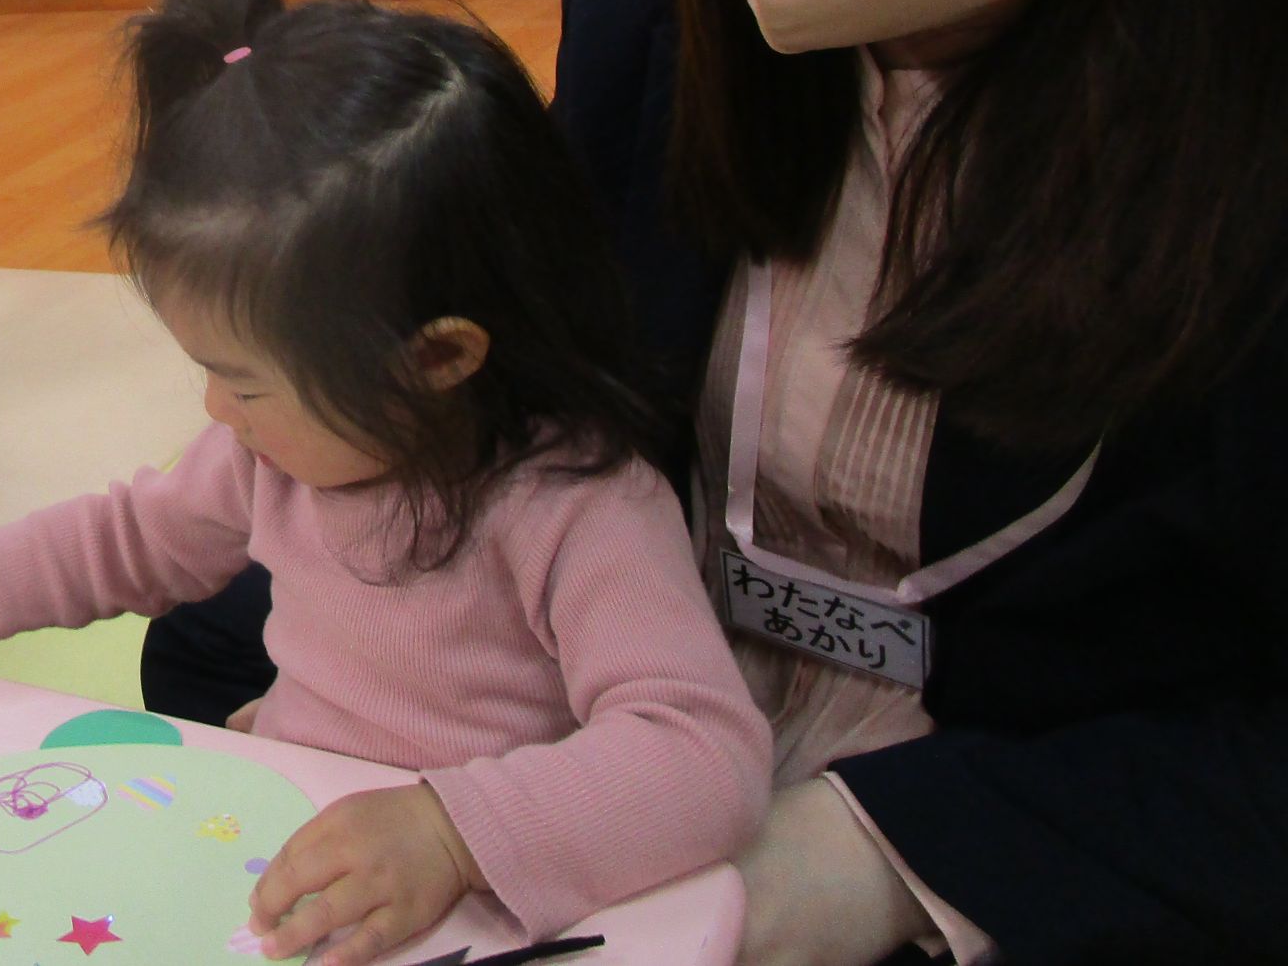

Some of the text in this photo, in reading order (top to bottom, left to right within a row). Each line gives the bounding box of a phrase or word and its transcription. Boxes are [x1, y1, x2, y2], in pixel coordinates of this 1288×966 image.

[733, 564, 916, 645] わたなべ
[764, 607, 887, 669] あかり
